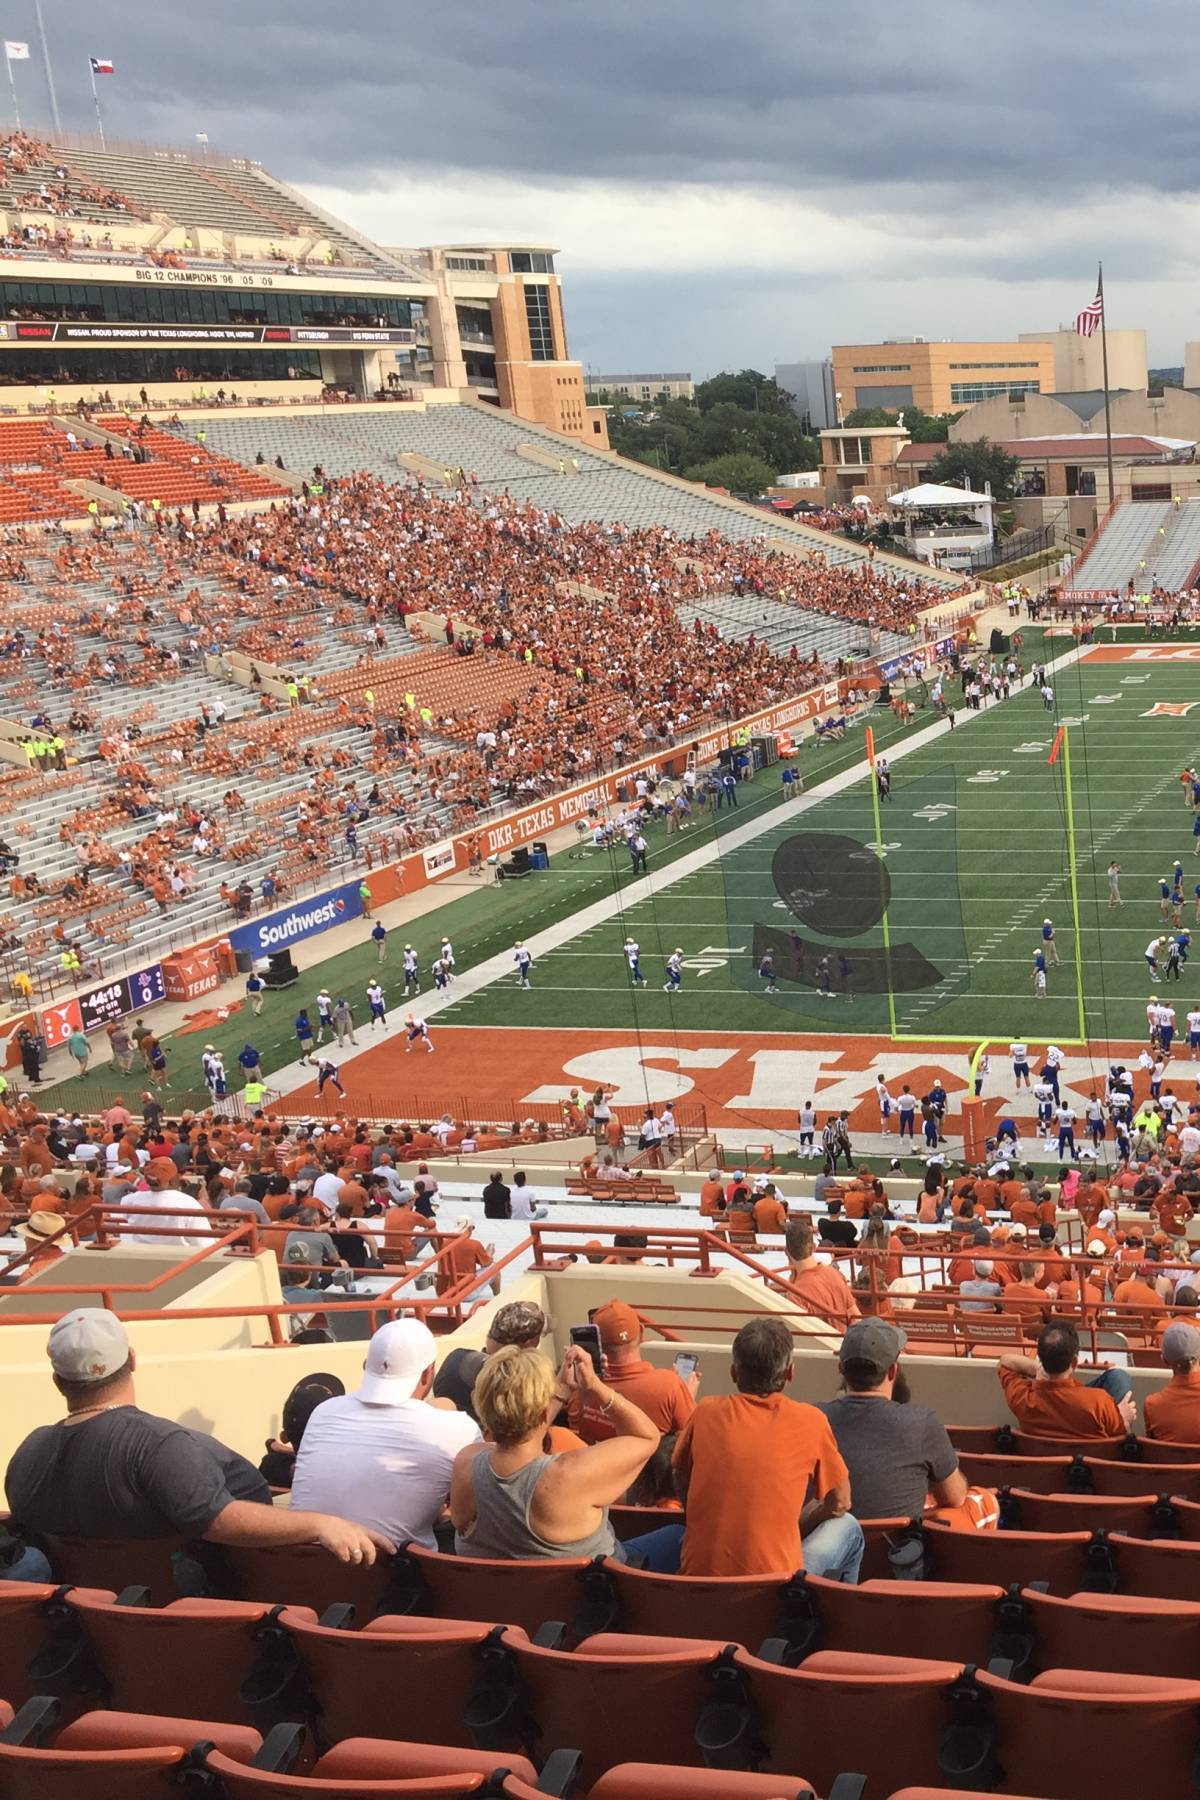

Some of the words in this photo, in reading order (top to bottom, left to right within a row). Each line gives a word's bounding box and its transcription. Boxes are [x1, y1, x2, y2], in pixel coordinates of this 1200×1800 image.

[136, 270, 151, 280] BIG
[155, 272, 164, 280] 12
[168, 272, 218, 284] CHAMPIONS
[220, 274, 234, 284] '96
[240, 276, 254, 285] '05
[1060, 591, 1095, 600] SMOKEY
[488, 806, 556, 850] DKR-TEXAS
[258, 900, 336, 948] Southwest
[681, 946, 748, 968] 10
[88, 984, 122, 1008] 44:18
[142, 988, 152, 1002] 0
[188, 974, 218, 997] TEXAS
[61, 1022, 72, 1038] 0
